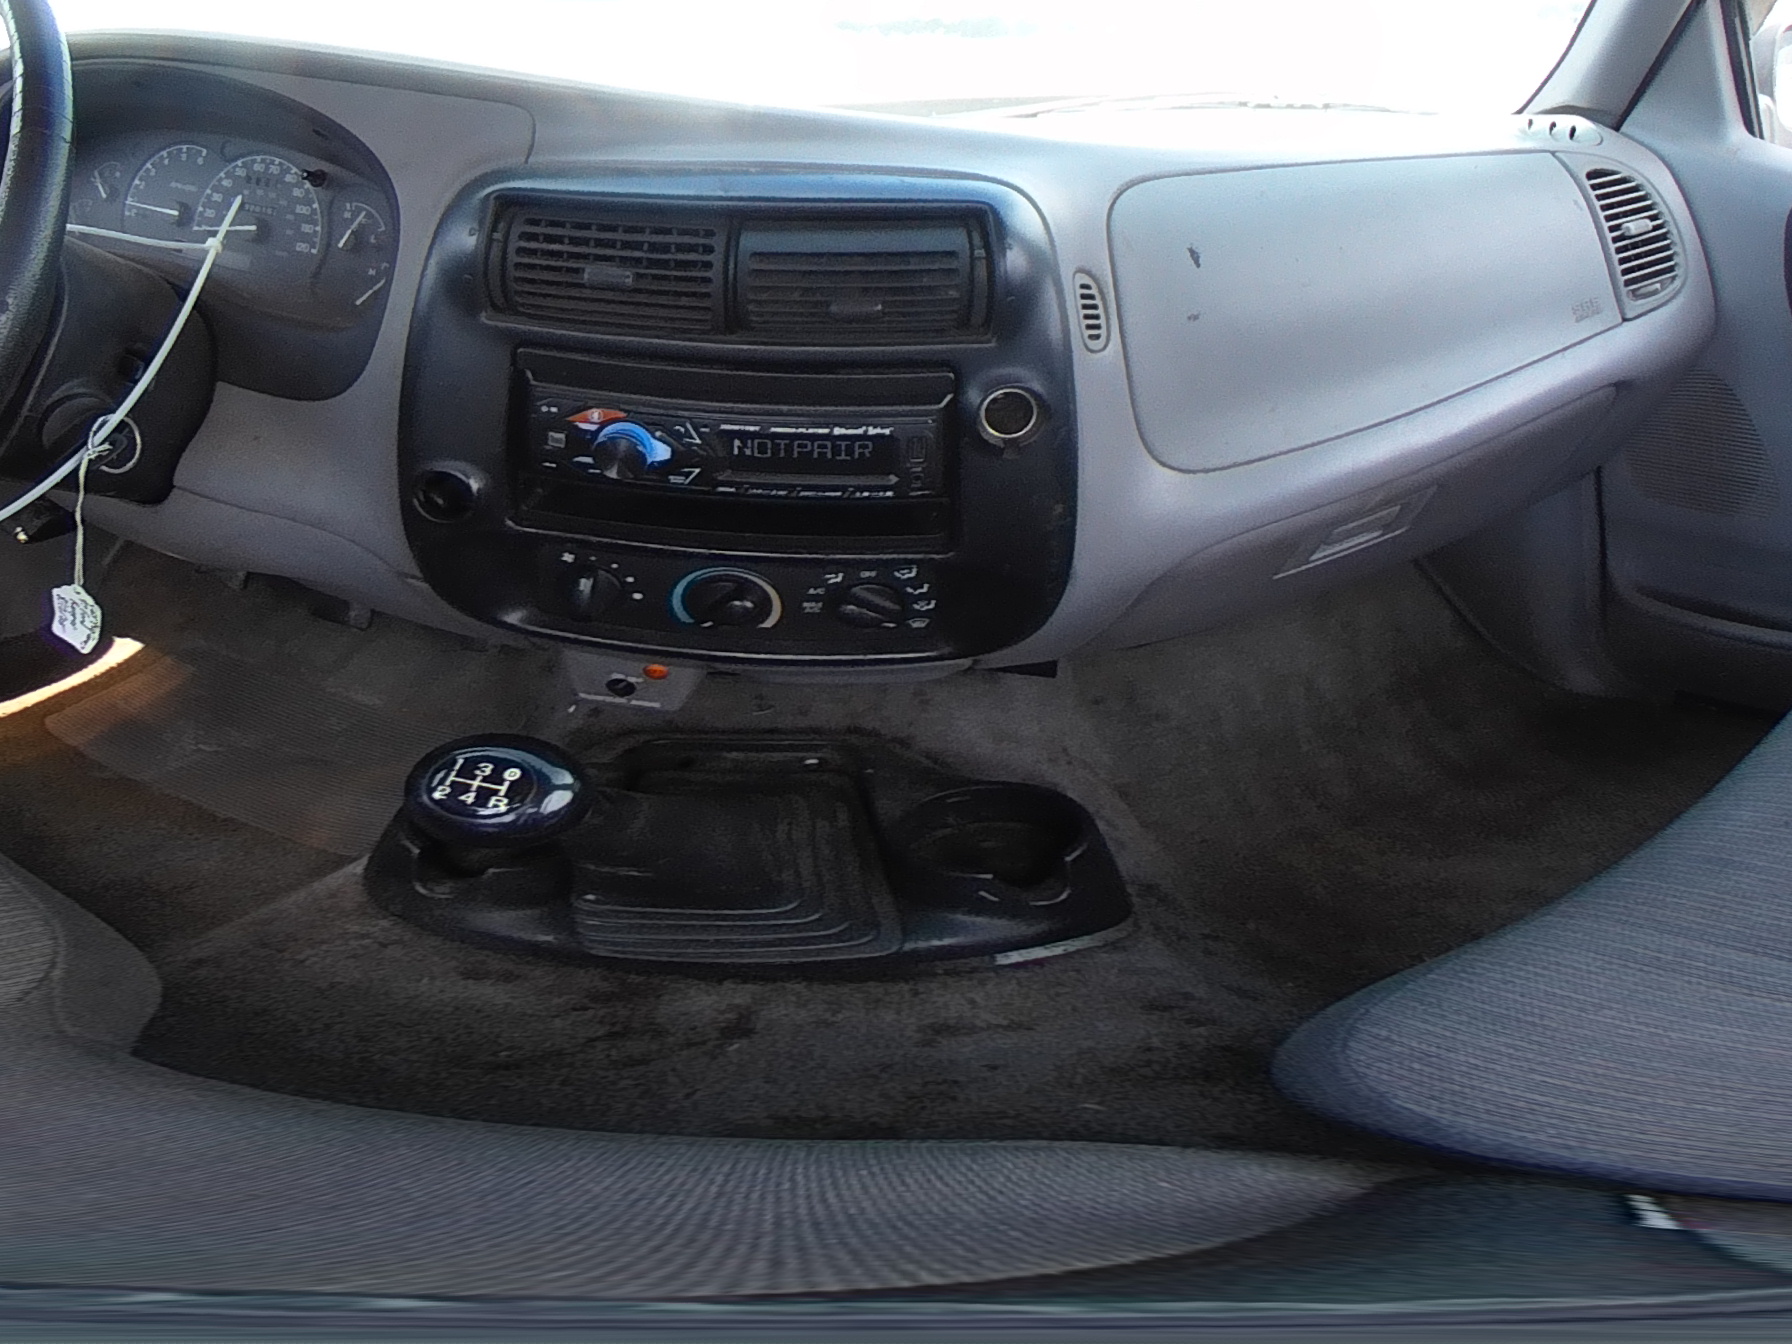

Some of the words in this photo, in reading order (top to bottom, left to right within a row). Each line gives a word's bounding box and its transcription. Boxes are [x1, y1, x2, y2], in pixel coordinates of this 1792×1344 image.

[473, 762, 495, 776] 3
[431, 785, 451, 800] 2
[457, 791, 477, 805] 4
[487, 795, 509, 811] R
